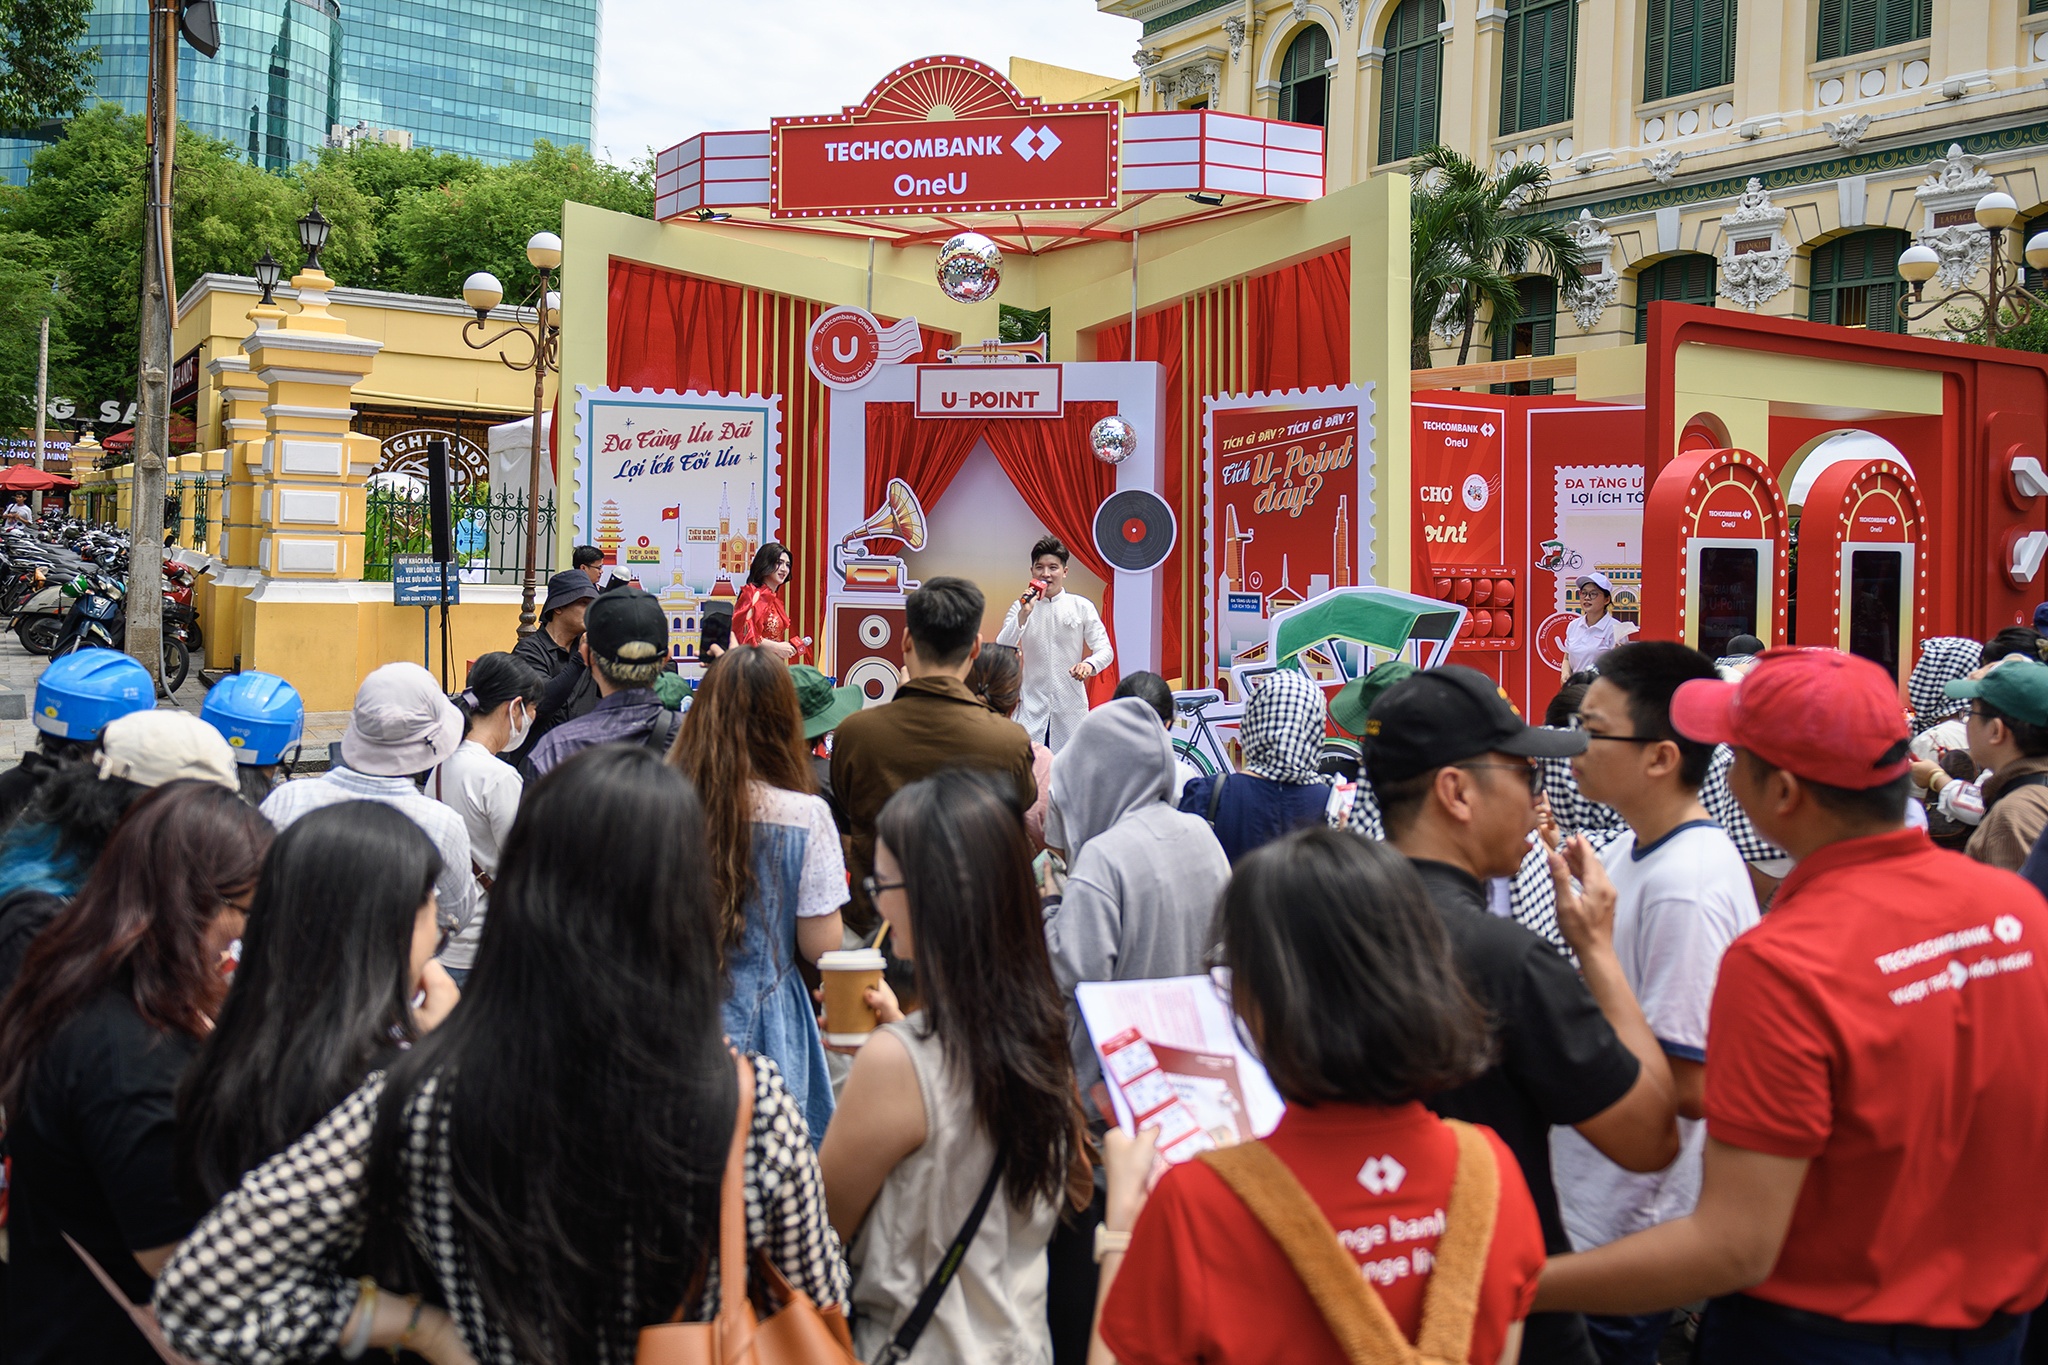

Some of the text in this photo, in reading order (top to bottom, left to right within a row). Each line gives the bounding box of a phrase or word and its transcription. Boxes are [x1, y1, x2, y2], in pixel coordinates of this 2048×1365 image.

[825, 136, 1002, 162] TECHCOMBANK
[893, 172, 968, 197] OneU
[817, 314, 874, 335] Techcombank OneU
[832, 336, 858, 363] U
[818, 361, 873, 382] Techcombank OneU
[941, 391, 1040, 409] U-POINT
[601, 420, 754, 453] Đa Tầng Ưu Đãi
[1223, 435, 1243, 450] TÍCH
[1245, 431, 1255, 444] GÌ
[1287, 420, 1310, 436] TÍCH
[1312, 416, 1322, 431] GÌ
[1423, 421, 1478, 433] TECHCOMBANK
[1444, 437, 1468, 448] OneU
[613, 446, 741, 482] Lợi Ích Tối Ưu
[1222, 435, 1354, 486] Tích U-Point
[1565, 475, 1644, 489] ĐA TẦNG Ư
[1253, 473, 1324, 518] đây?
[1420, 485, 1453, 505] CHỢ
[1571, 492, 1593, 506] LỢI
[1598, 491, 1622, 503] ÍCH
[1423, 514, 1468, 544] oint
[1252, 577, 1259, 585] U
